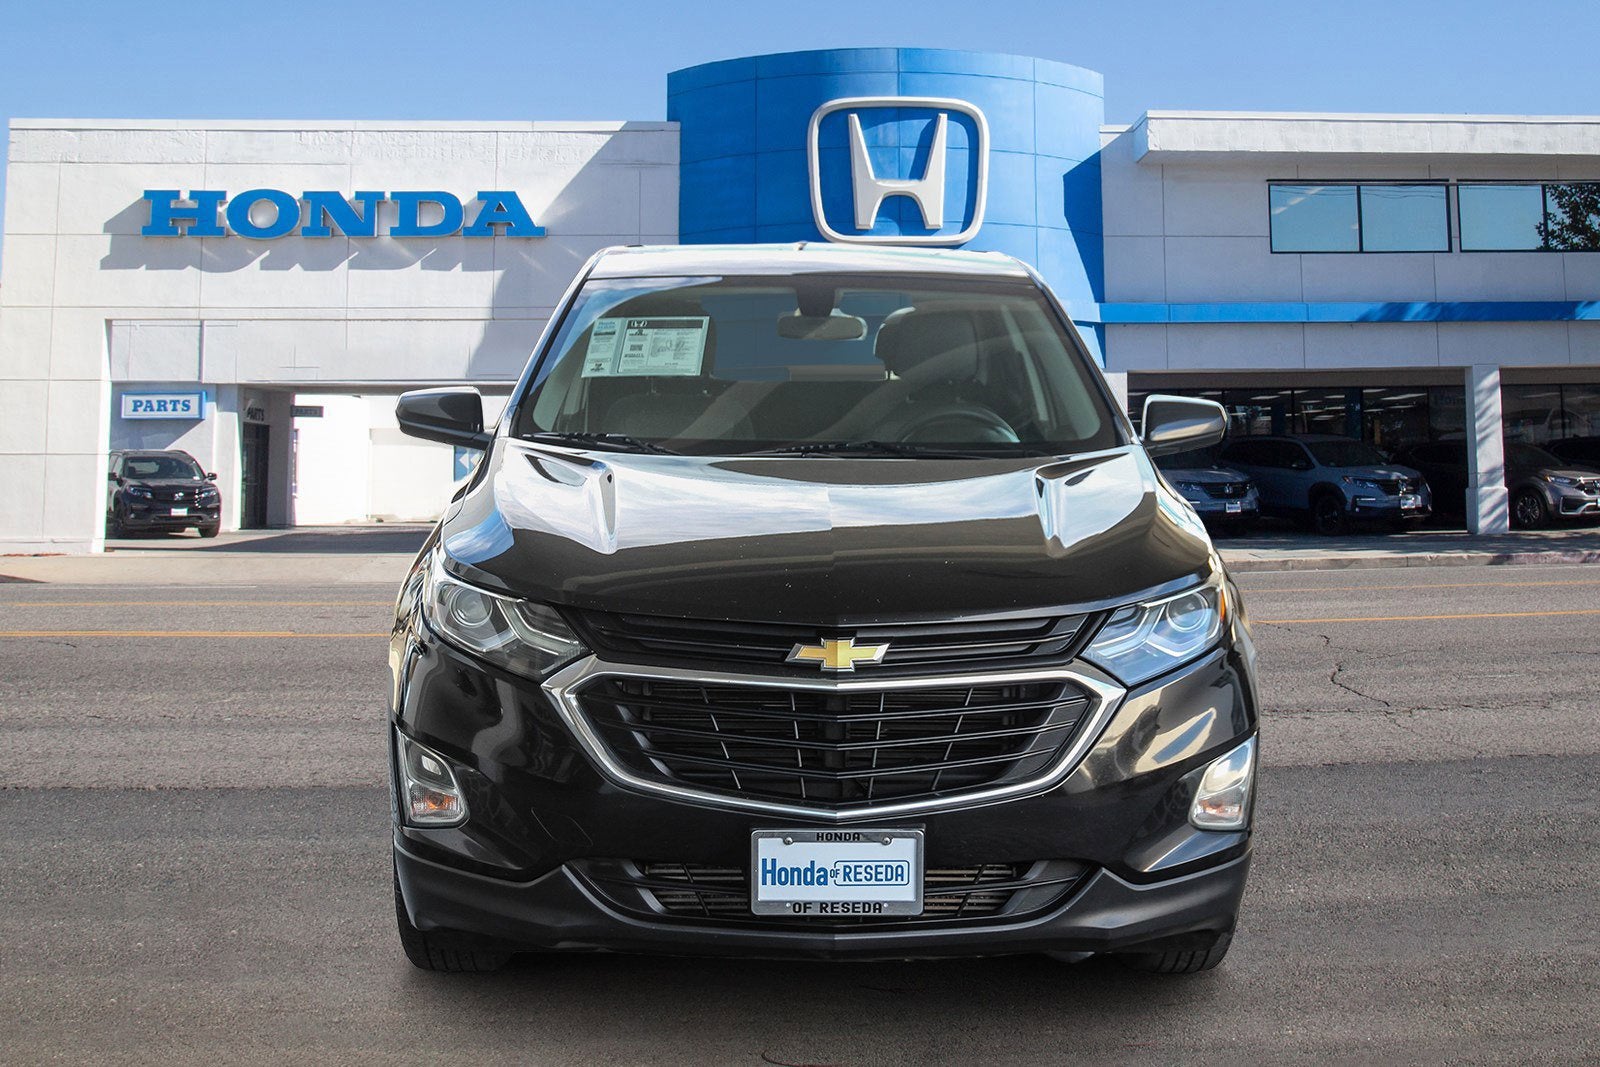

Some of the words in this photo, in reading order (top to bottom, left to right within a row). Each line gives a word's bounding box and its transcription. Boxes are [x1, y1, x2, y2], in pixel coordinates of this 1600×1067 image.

[141, 188, 547, 239] HONDA
[131, 399, 192, 412] PARTS
[816, 832, 861, 842] HONDA
[761, 858, 828, 886] Honda
[830, 868, 840, 879] OF
[843, 864, 904, 882] RESEDA
[792, 902, 813, 914] OF
[820, 902, 882, 914] RESEDA
